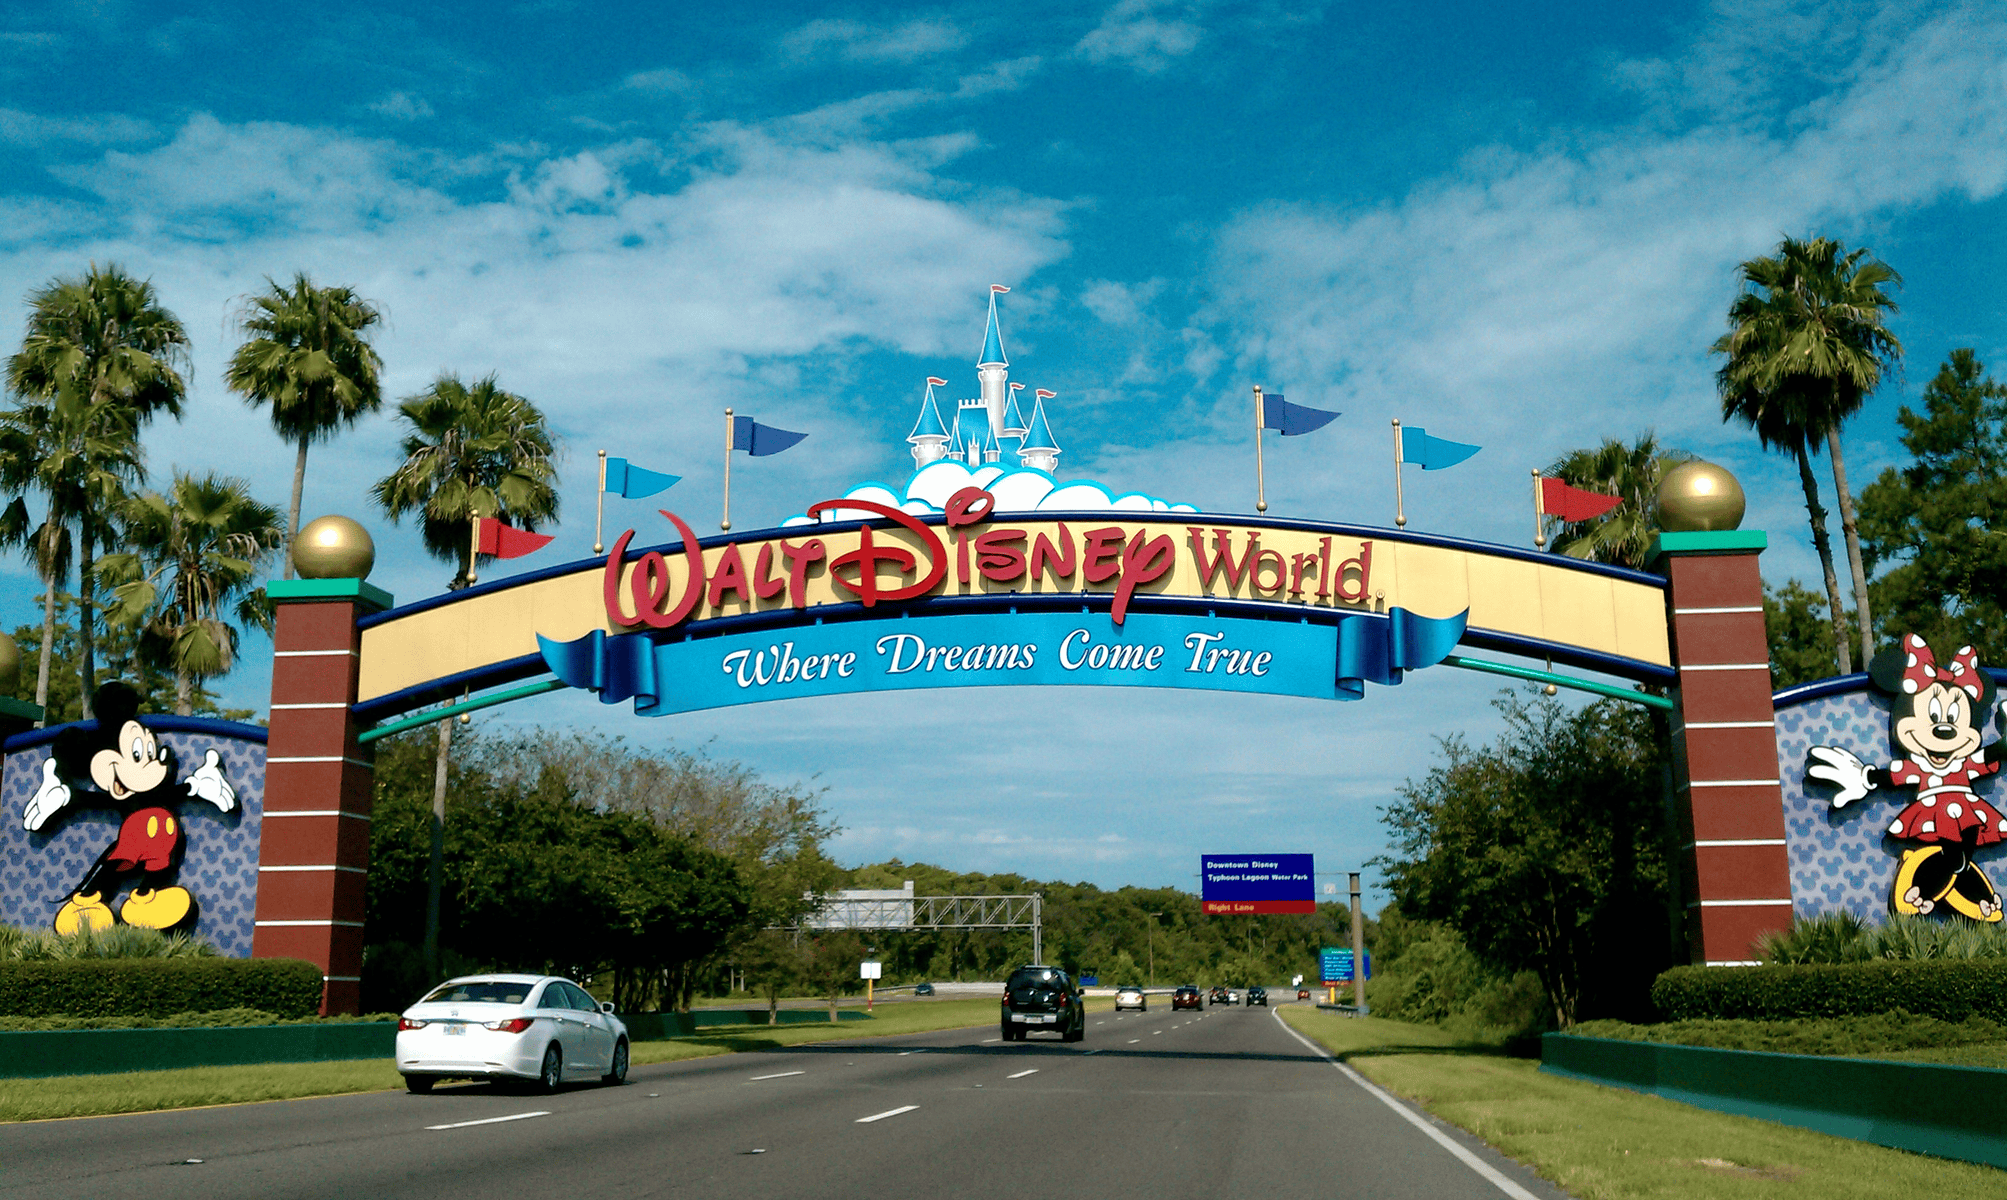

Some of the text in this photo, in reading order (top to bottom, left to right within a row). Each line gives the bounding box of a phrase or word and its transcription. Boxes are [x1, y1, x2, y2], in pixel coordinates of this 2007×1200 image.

[604, 509, 825, 629] WALT
[1186, 526, 1373, 600] World
[722, 628, 1273, 688] Where Dreams Come True
[1207, 861, 1279, 870] Downtown Disney
[1208, 874, 1240, 883] Typhoon
[1241, 873, 1270, 882] Lagoon
[1292, 873, 1309, 881] Park
[1208, 903, 1255, 913] Right Lane
